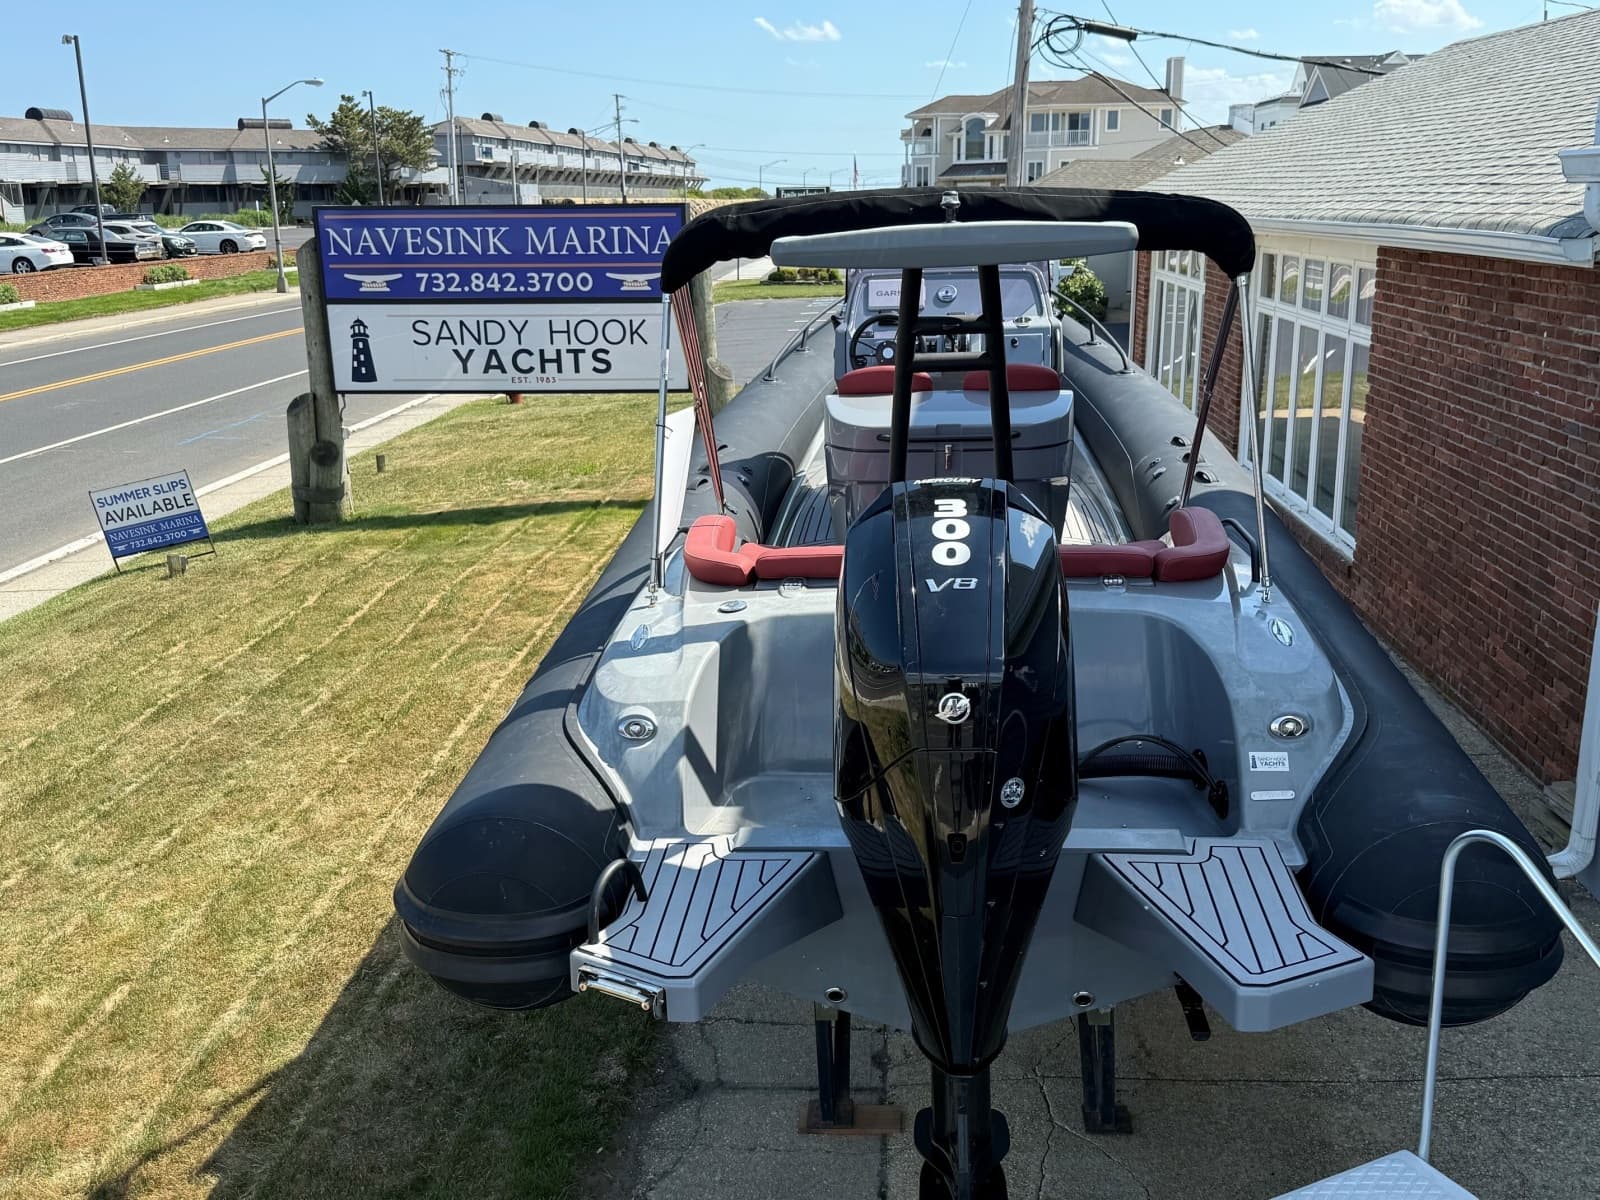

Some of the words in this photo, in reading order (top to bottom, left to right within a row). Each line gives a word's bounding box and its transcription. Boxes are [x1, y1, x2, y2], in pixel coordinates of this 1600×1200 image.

[324, 226, 512, 256] NAVESINK
[524, 225, 671, 255] MARINA
[415, 271, 594, 293] 732.842.3700
[412, 319, 529, 346] SANDY
[548, 318, 648, 346] HOOK
[451, 348, 613, 374] YACHTS
[511, 376, 532, 384] EST.
[536, 376, 557, 384] 1983
[96, 487, 152, 508] SUMMER
[152, 479, 187, 496] SLIPS
[913, 477, 982, 485] MERCURY
[105, 493, 195, 525] AVAILABLE
[109, 523, 158, 542] NAVESINK
[160, 514, 201, 531] MARINA
[129, 530, 187, 549] 732.842.3700
[931, 498, 971, 566] 300
[925, 577, 979, 593] V8
